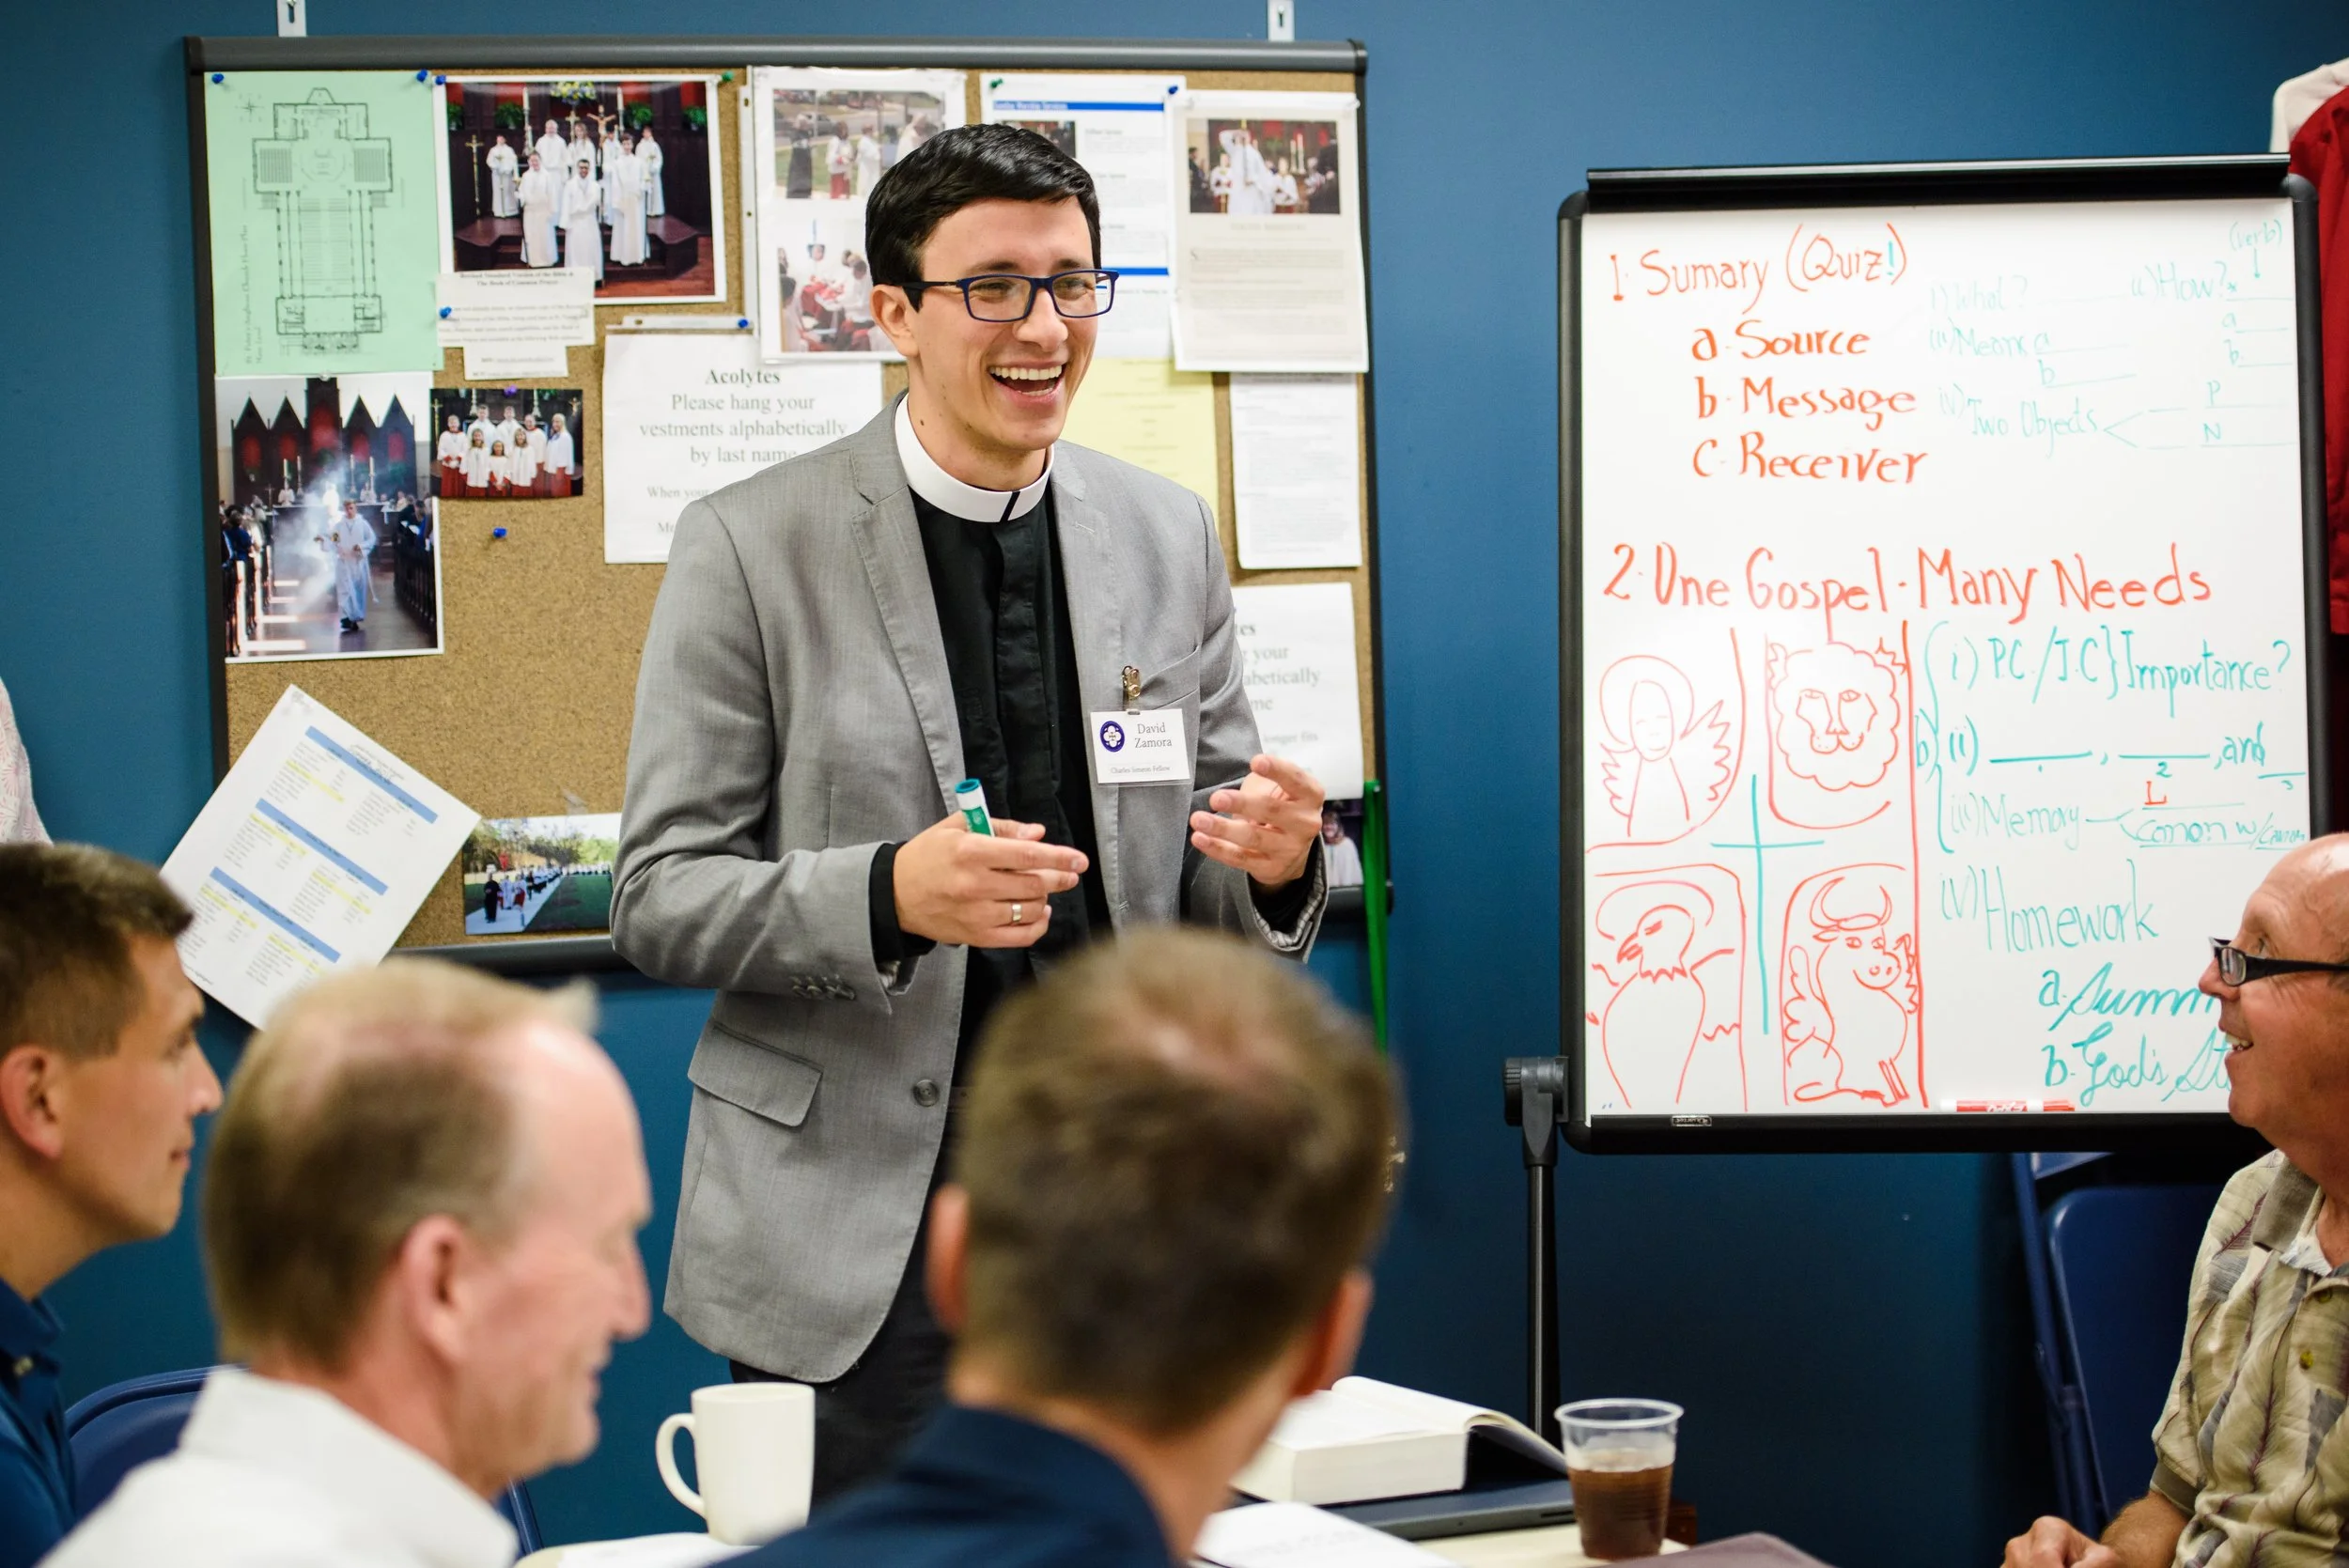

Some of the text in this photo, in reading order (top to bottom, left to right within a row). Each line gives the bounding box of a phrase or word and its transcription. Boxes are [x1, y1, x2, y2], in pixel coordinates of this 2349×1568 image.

[1641, 249, 1768, 315] Sumary
[1735, 319, 1871, 359] Source
[706, 367, 781, 388] Acolytes
[672, 394, 816, 414] Please hang your
[1742, 377, 1917, 431] Message
[639, 419, 848, 441] vestments alphabetically
[691, 447, 711, 467] by
[717, 447, 745, 462] last
[1739, 431, 1928, 484] Receiver
[646, 486, 680, 498] When
[1655, 542, 1732, 607] One
[1746, 547, 1889, 644] Gospel
[1918, 547, 2039, 624] Many
[2051, 542, 2212, 612] Needs
[1252, 646, 1289, 665] your
[1243, 667, 1321, 687] abetically
[1137, 722, 1166, 734] David
[1134, 737, 1173, 749] Zamora
[1981, 859, 2159, 954] Homework
[2047, 961, 2216, 1032] Summ
[2072, 1021, 2169, 1107] God's
